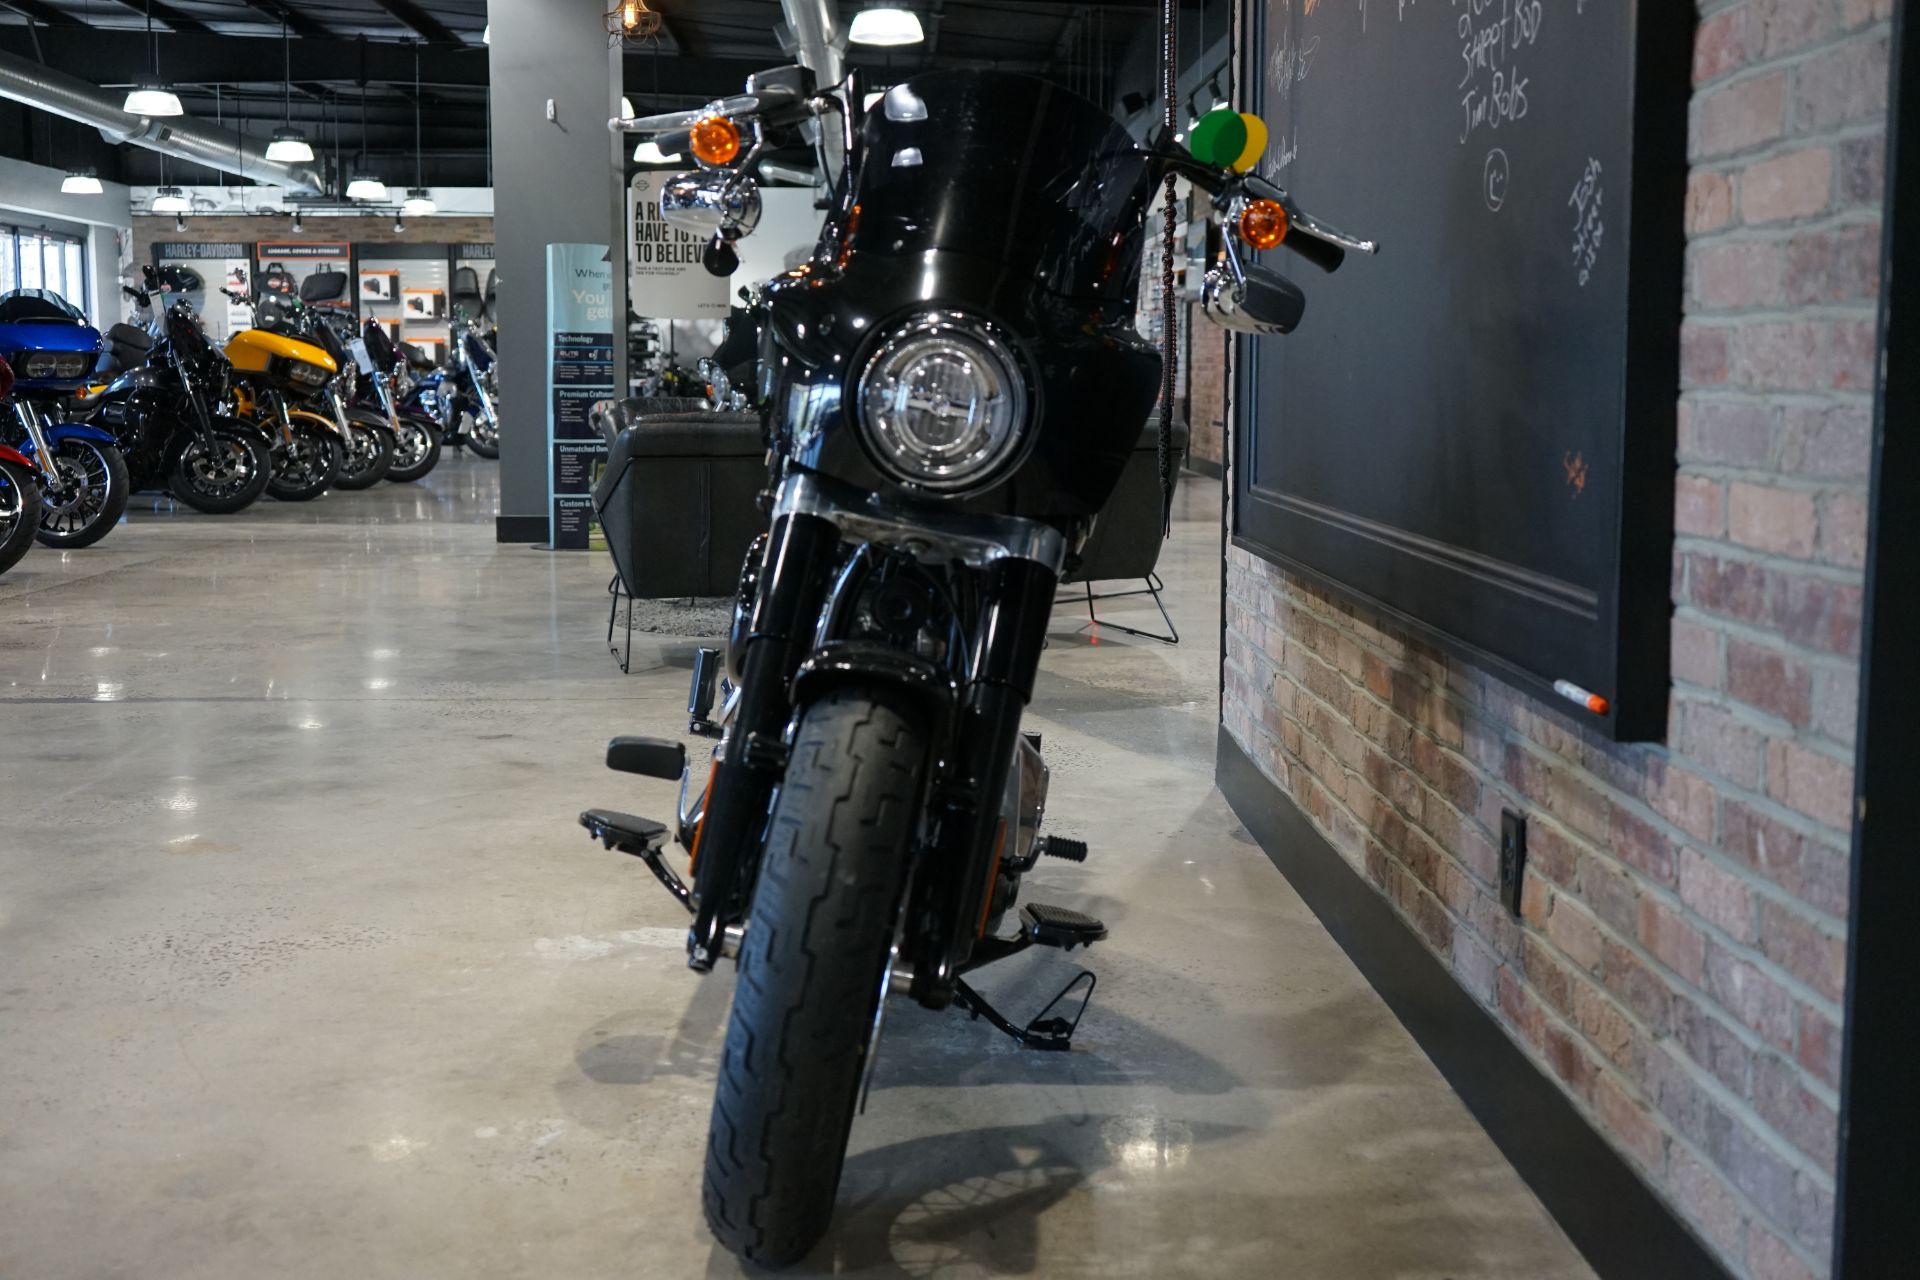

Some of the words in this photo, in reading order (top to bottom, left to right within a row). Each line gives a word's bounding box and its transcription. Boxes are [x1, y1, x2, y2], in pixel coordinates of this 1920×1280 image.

[635, 201, 644, 221] A
[636, 222, 669, 242] HAVE
[164, 243, 243, 258] HARLEY-DAVIDSON
[635, 243, 652, 263] TO
[656, 244, 706, 264] BELIEV
[571, 289, 606, 305] You
[558, 335, 593, 344] Technology
[560, 390, 588, 398] Premium
[560, 445, 596, 453] Unmatched
[559, 500, 585, 508] Custom
